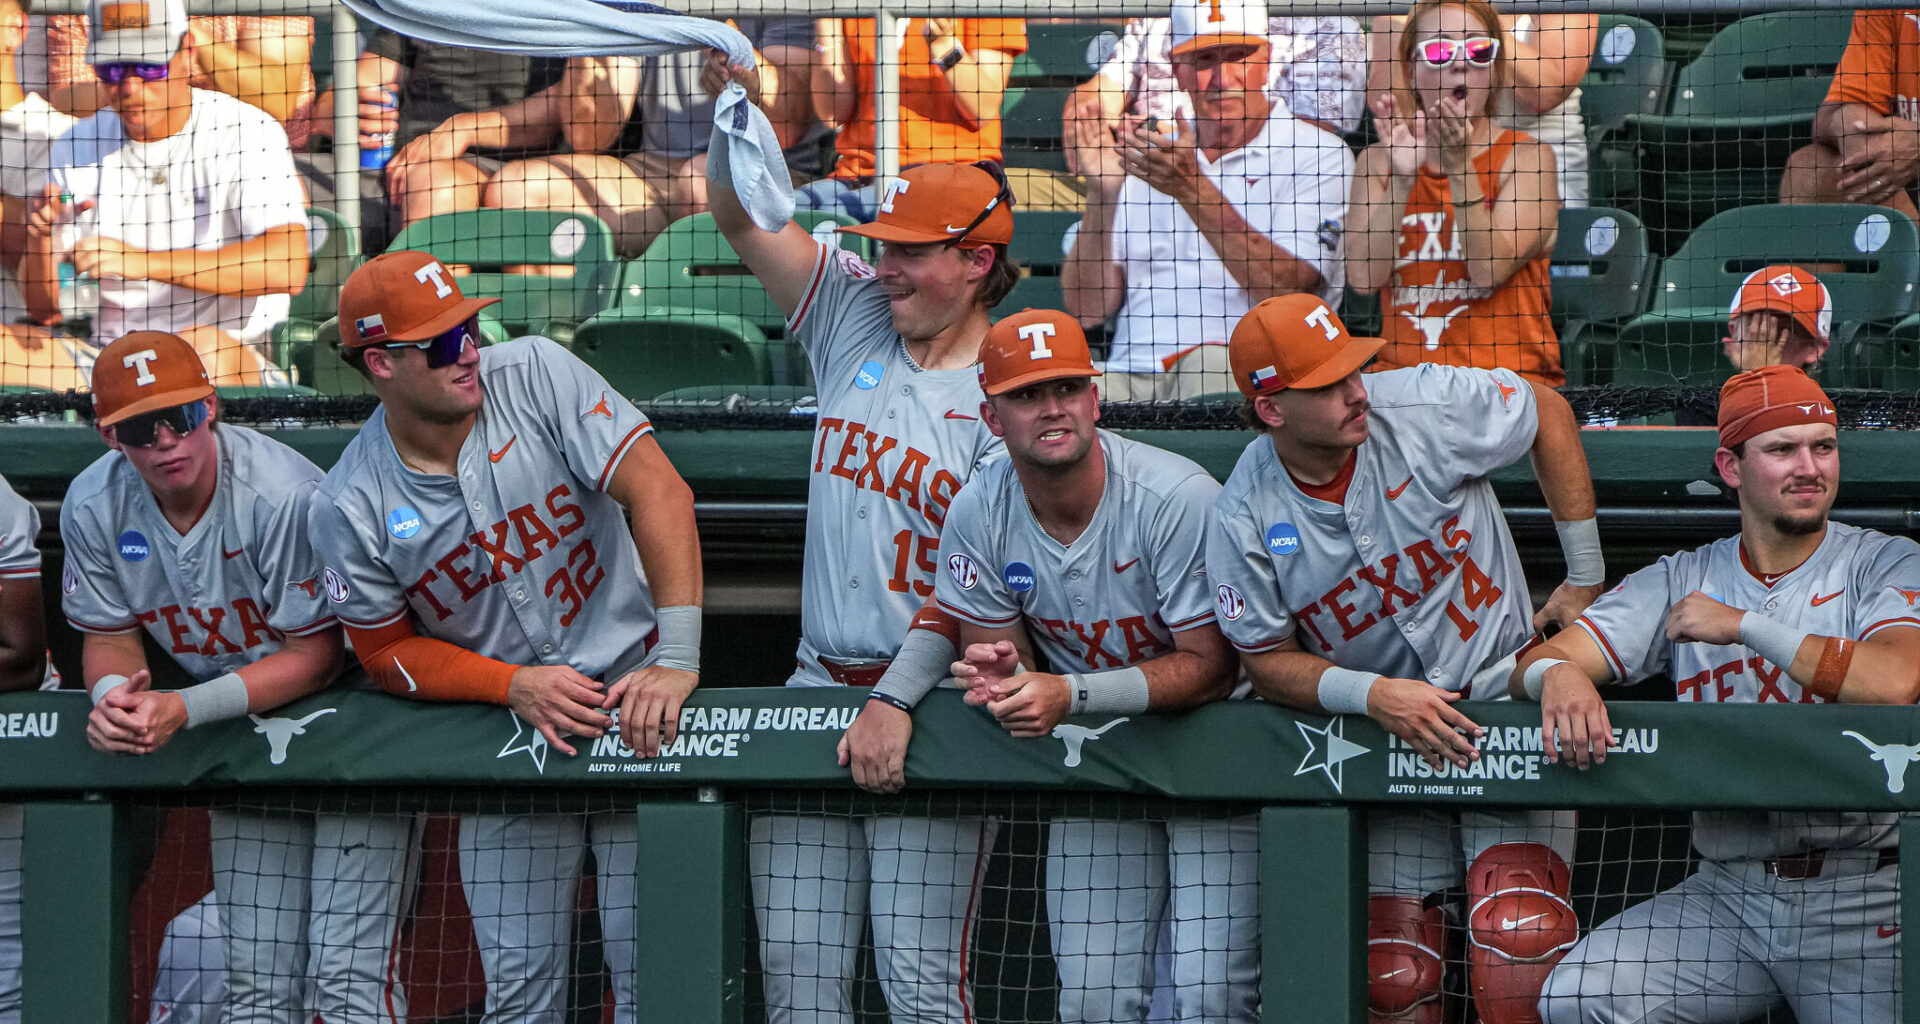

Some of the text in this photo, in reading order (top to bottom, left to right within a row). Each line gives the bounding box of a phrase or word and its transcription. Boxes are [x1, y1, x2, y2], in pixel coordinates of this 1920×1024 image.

[1199, 0, 1225, 23] T
[880, 176, 910, 214] T
[414, 261, 453, 299] T
[1018, 322, 1056, 360] T
[1303, 304, 1340, 341] T
[123, 349, 157, 386] T
[814, 417, 962, 529] TEXAS
[393, 518, 420, 534] NCAA
[1271, 536, 1299, 547] NCAA
[121, 545, 148, 555] NCAA
[405, 483, 586, 622] TEXAS
[888, 530, 942, 597] 15
[544, 538, 606, 628] 32
[950, 555, 977, 589] SEC
[1008, 576, 1034, 585] NCAA
[1296, 514, 1472, 652] TEXAS
[1445, 555, 1503, 643] 14
[136, 597, 284, 656] EXA
[679, 707, 751, 731] FARM
[754, 706, 860, 731] BUREAU
[1473, 726, 1544, 751] FARM
[588, 763, 616, 773] AUTO
[623, 763, 651, 773] HOME
[659, 763, 681, 773] LIFE
[1388, 784, 1416, 794] AUTO
[1424, 785, 1454, 795] HOME
[1462, 786, 1484, 796] LIFE
